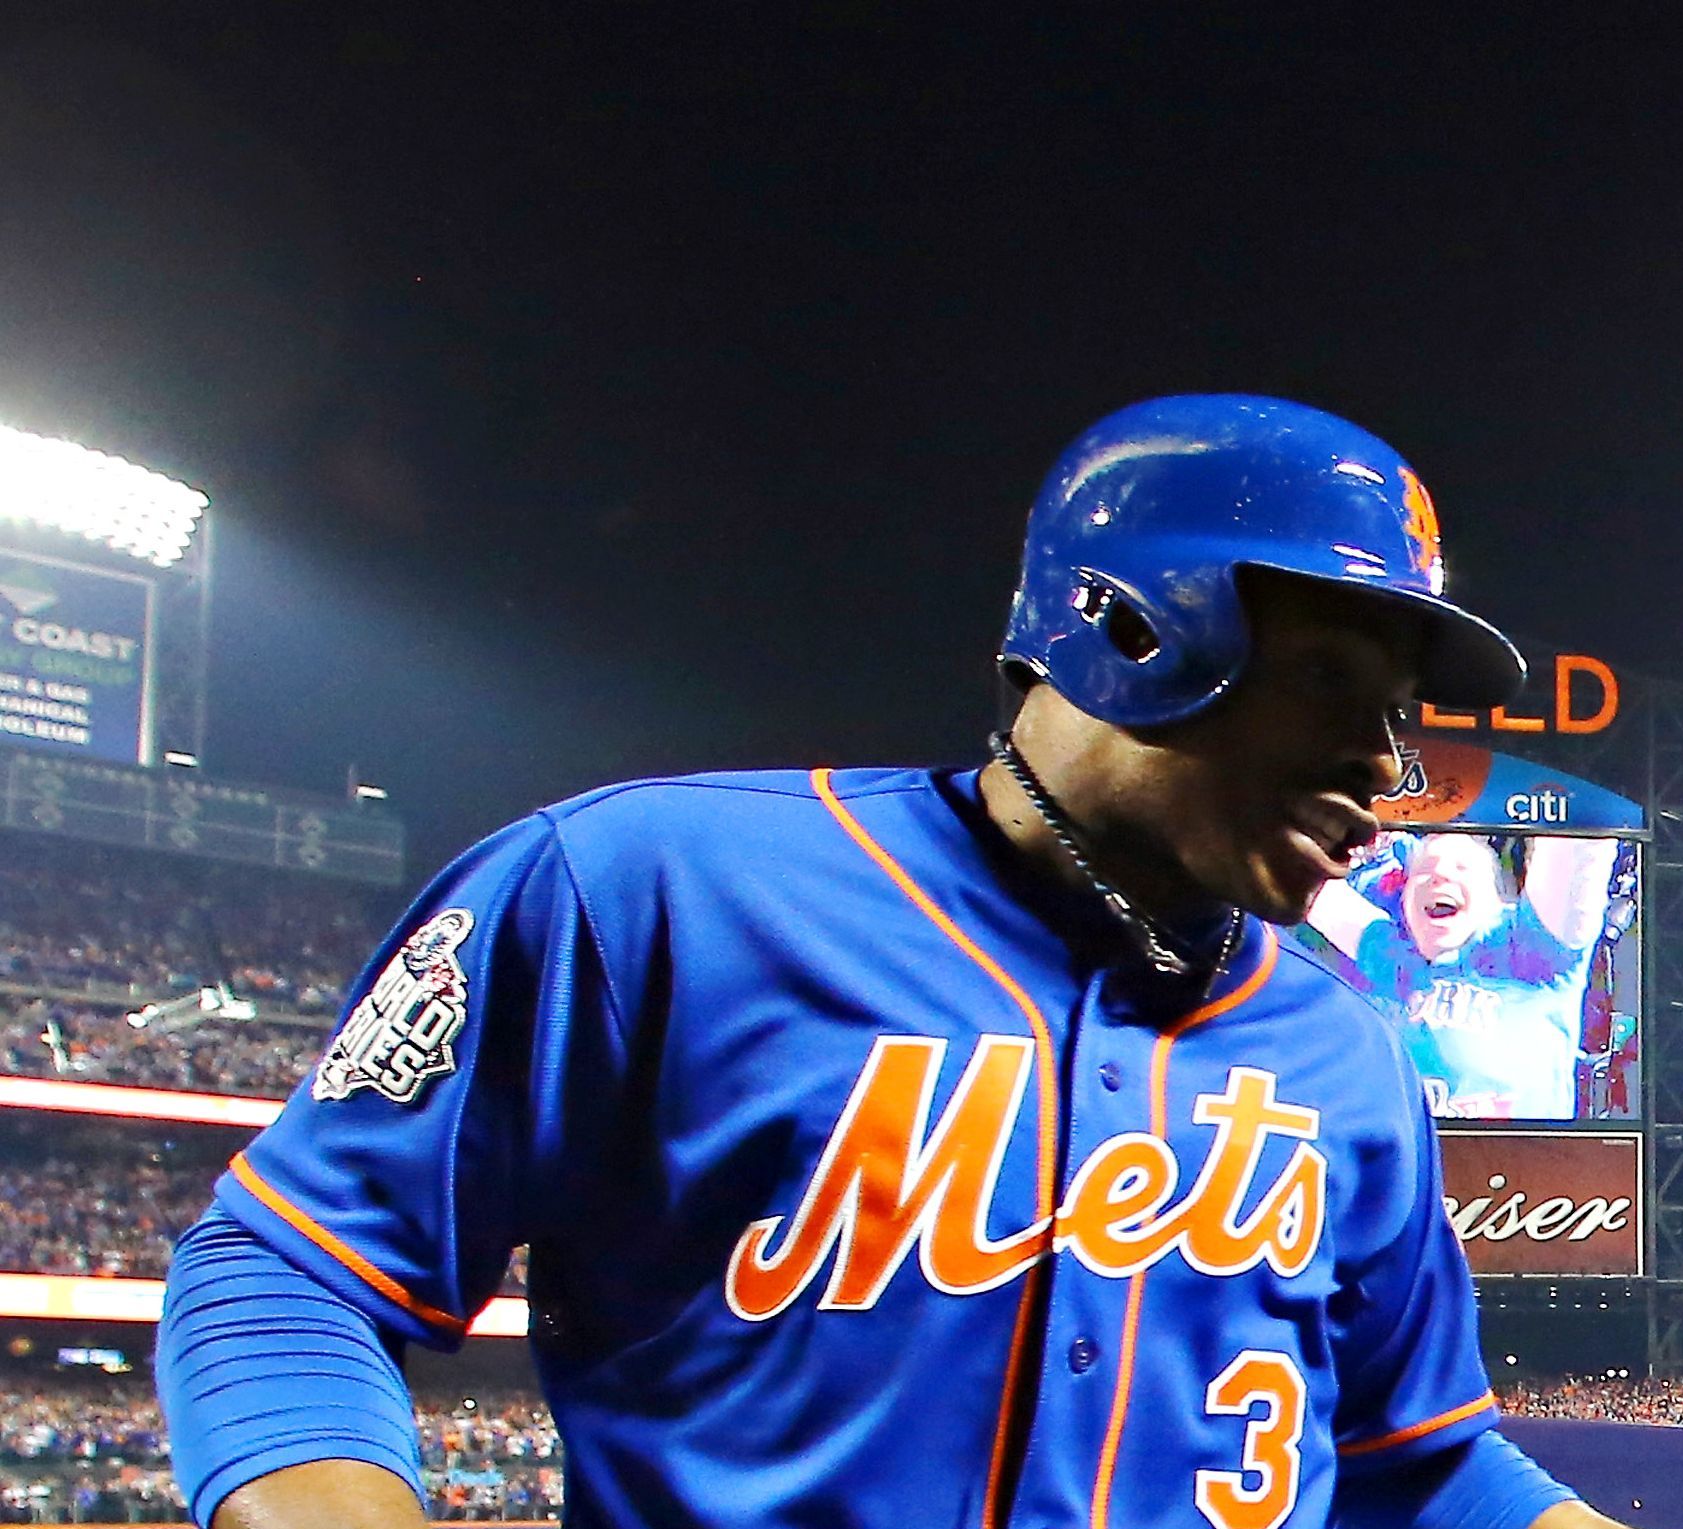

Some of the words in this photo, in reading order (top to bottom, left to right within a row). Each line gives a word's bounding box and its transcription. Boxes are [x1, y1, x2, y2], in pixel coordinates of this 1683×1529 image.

[12, 617, 136, 663] COAST
[1505, 788, 1568, 823] citi
[725, 1033, 1328, 1322] Mets
